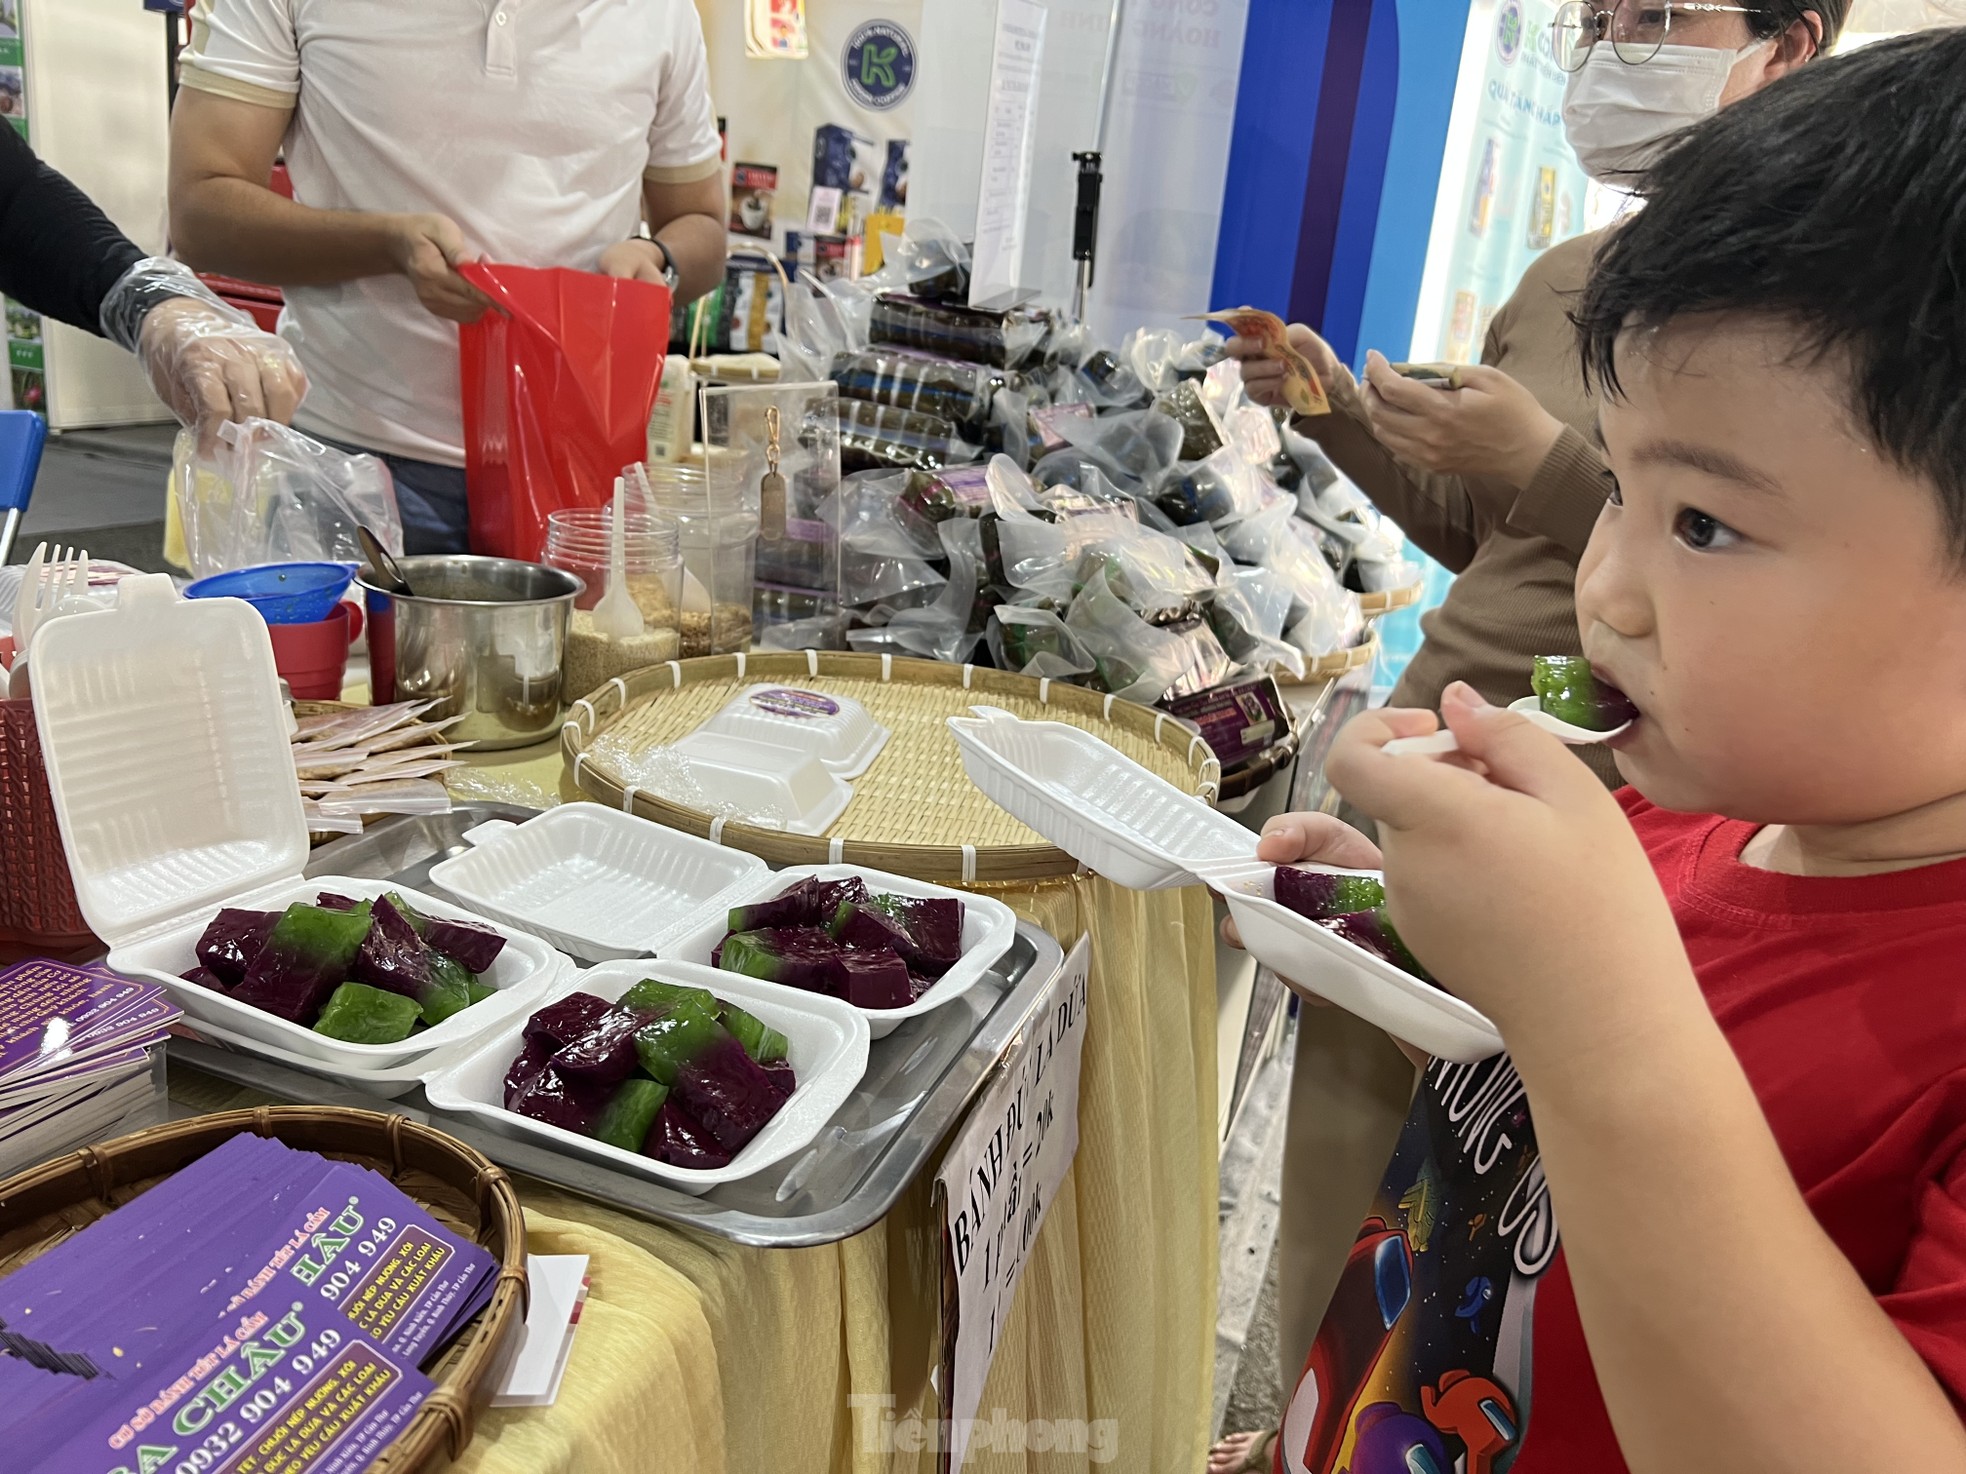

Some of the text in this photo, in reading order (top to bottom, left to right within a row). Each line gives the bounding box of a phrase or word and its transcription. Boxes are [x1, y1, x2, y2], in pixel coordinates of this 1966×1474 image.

[289, 1204, 365, 1287] HÂU
[954, 1123, 1003, 1277] BÁNH
[319, 1217, 396, 1300] 904 949
[174, 1328, 342, 1474] 0932 904 949
